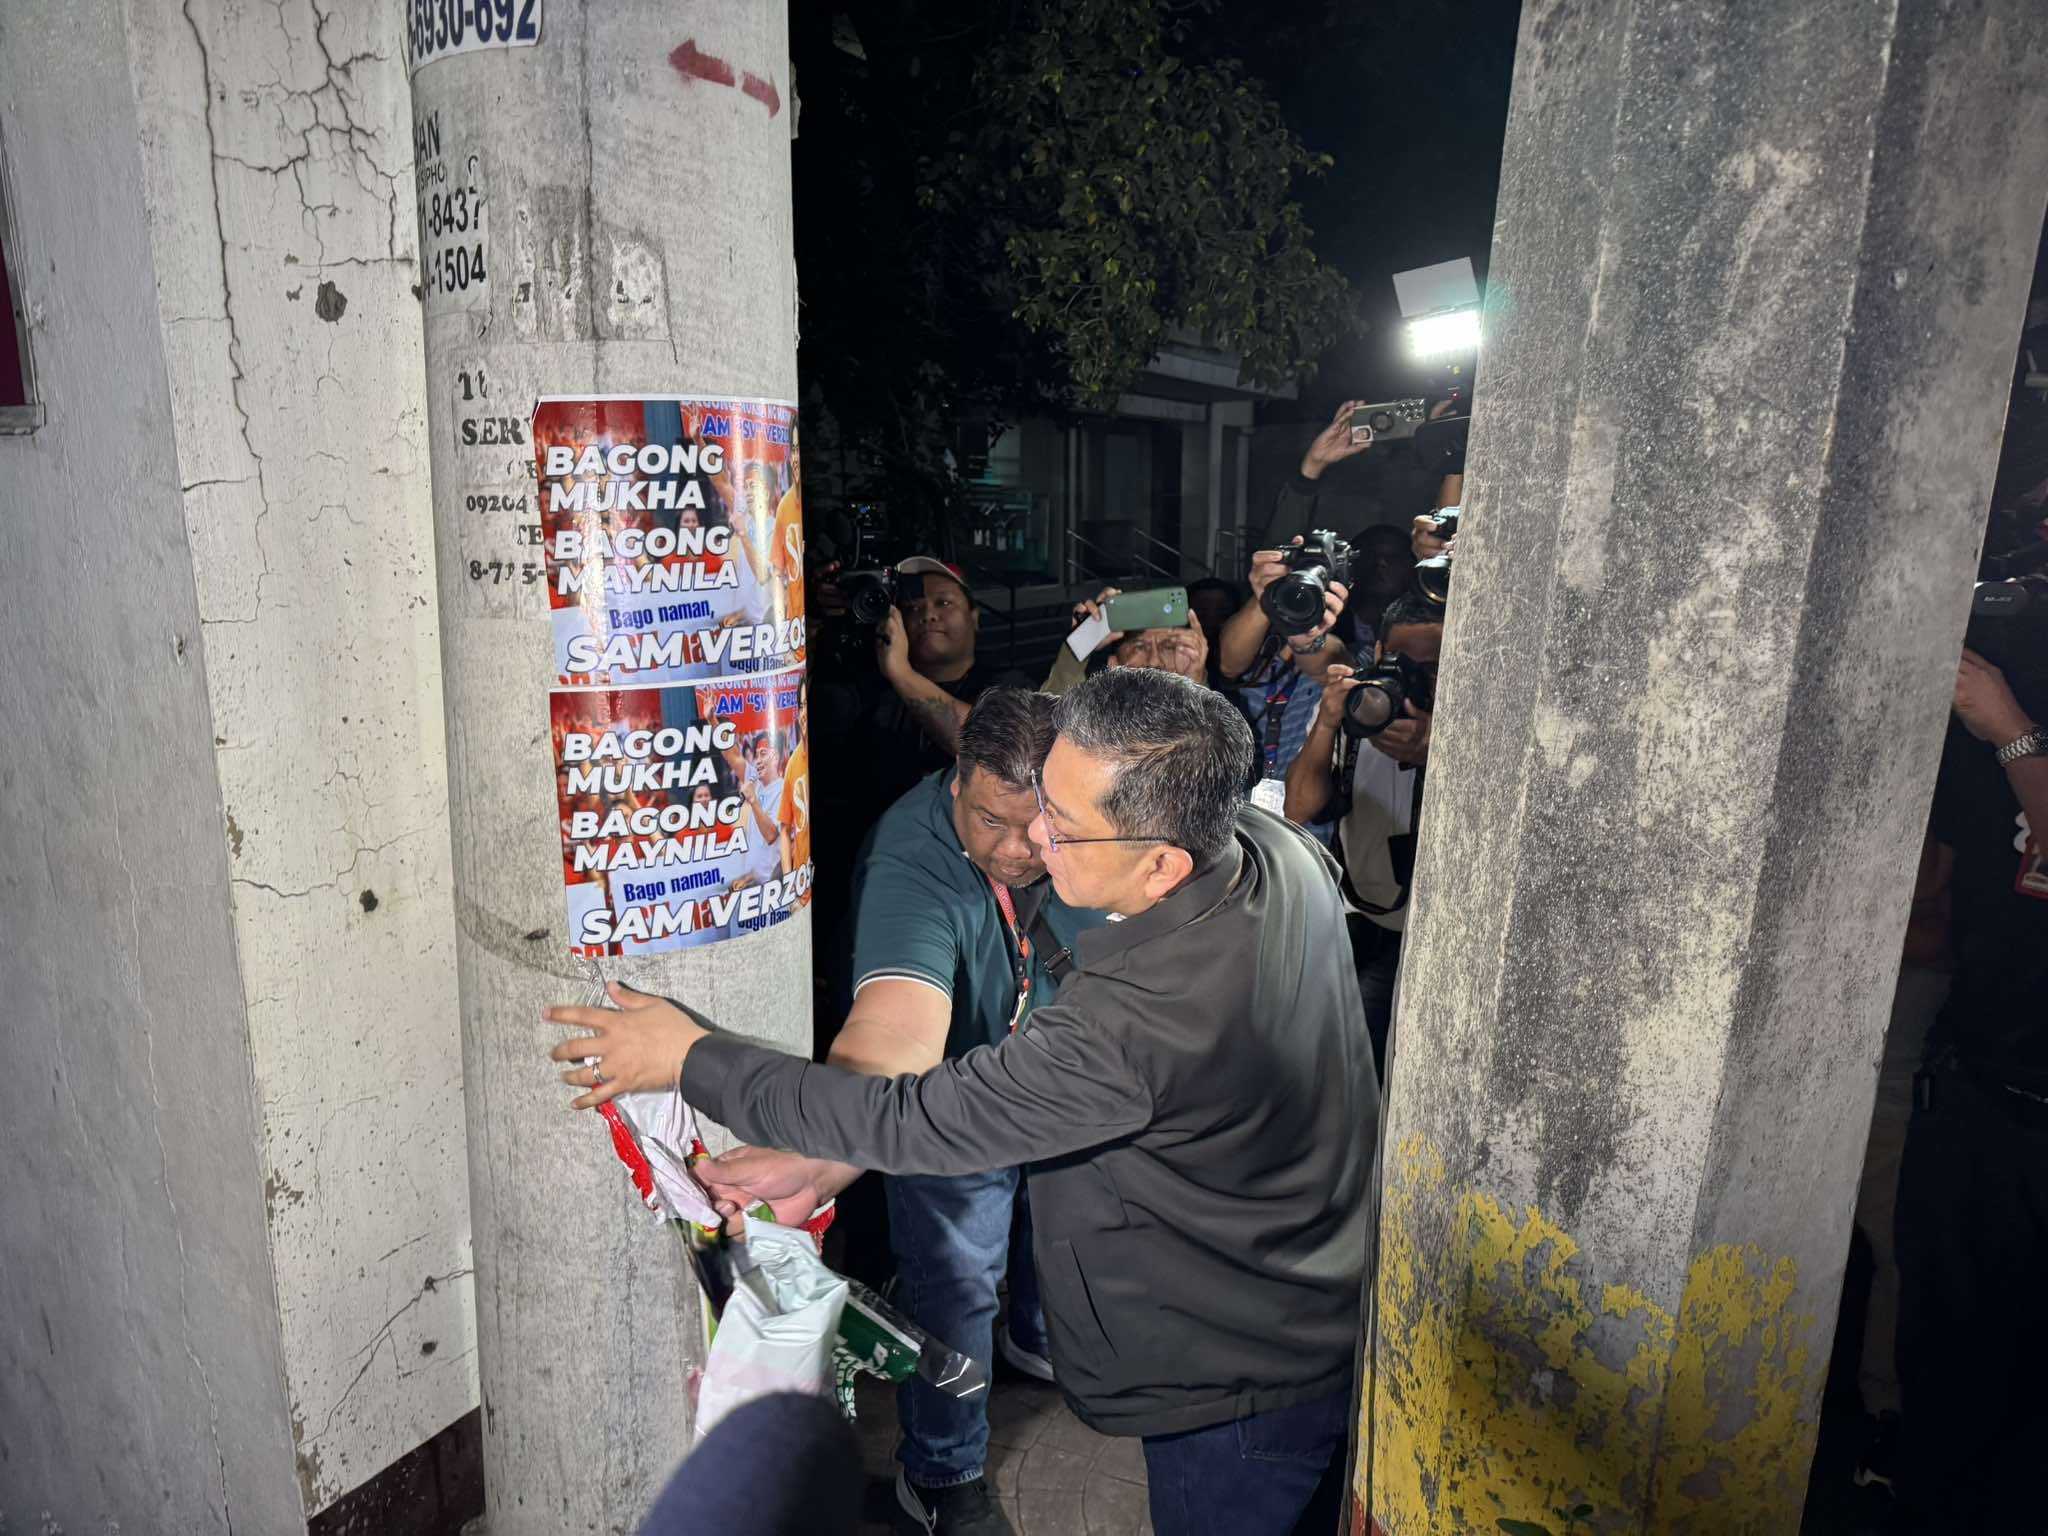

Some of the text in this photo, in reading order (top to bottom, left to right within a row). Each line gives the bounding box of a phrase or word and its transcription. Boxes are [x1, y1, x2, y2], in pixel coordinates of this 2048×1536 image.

[461, 417, 531, 446] SER
[702, 413, 731, 438] AM
[545, 444, 725, 477] BAGONG
[549, 480, 706, 513] MUKHA
[554, 525, 732, 560] BAGONG
[557, 560, 740, 595] MAYNILA
[609, 600, 714, 630] Bago naman,
[566, 631, 685, 674] SAM
[716, 692, 744, 714] AM
[563, 722, 737, 762] BAGONG
[567, 757, 719, 796] MUKHA
[570, 795, 743, 840] BAGONG
[573, 826, 749, 873] MAYNILA
[623, 867, 725, 903] Bago naman,
[579, 900, 697, 946] SAM
